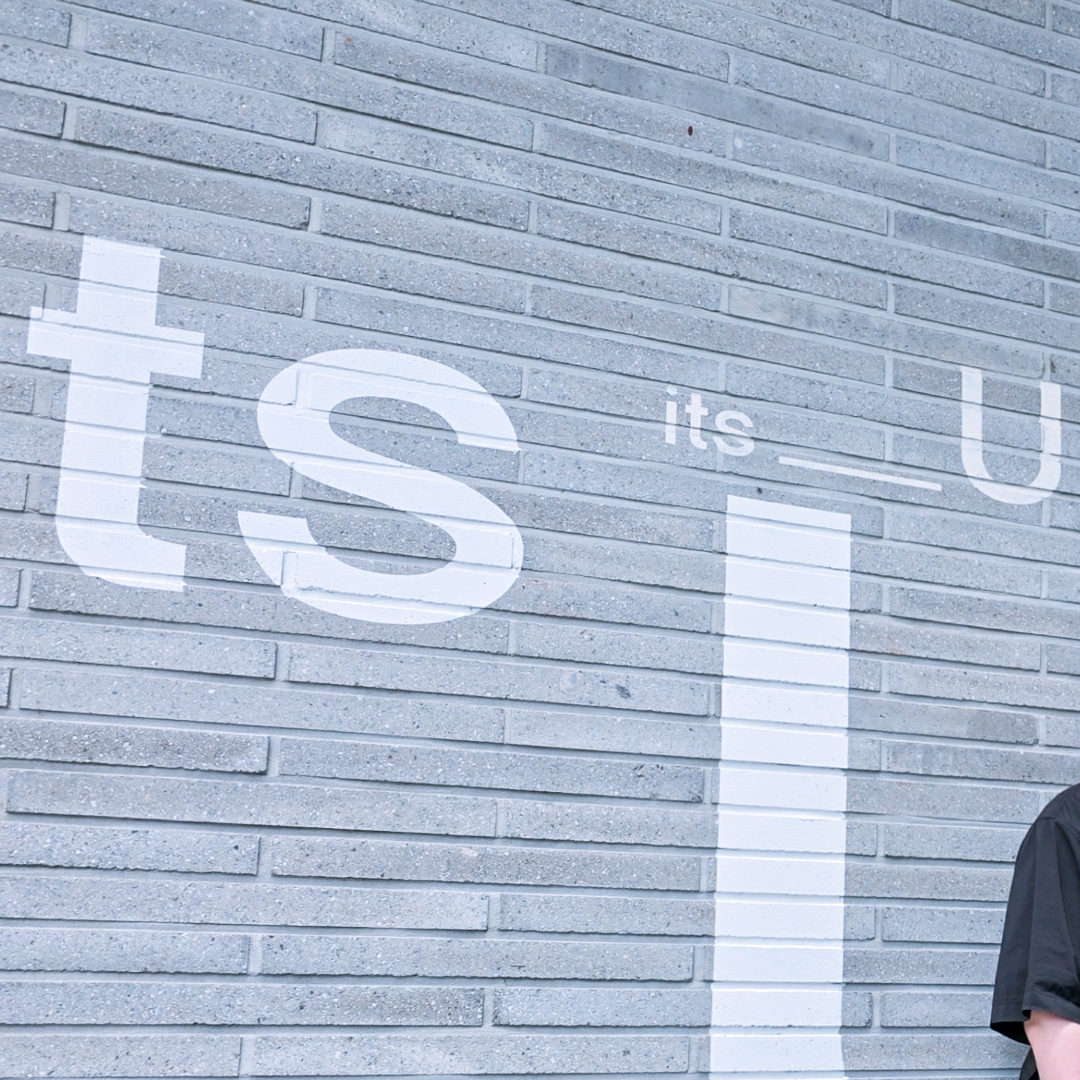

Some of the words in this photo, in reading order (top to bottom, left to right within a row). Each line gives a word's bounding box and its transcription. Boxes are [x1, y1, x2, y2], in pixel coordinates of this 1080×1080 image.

[26, 235, 524, 625] ts
[663, 385, 756, 457] its
[960, 366, 1062, 506] U
